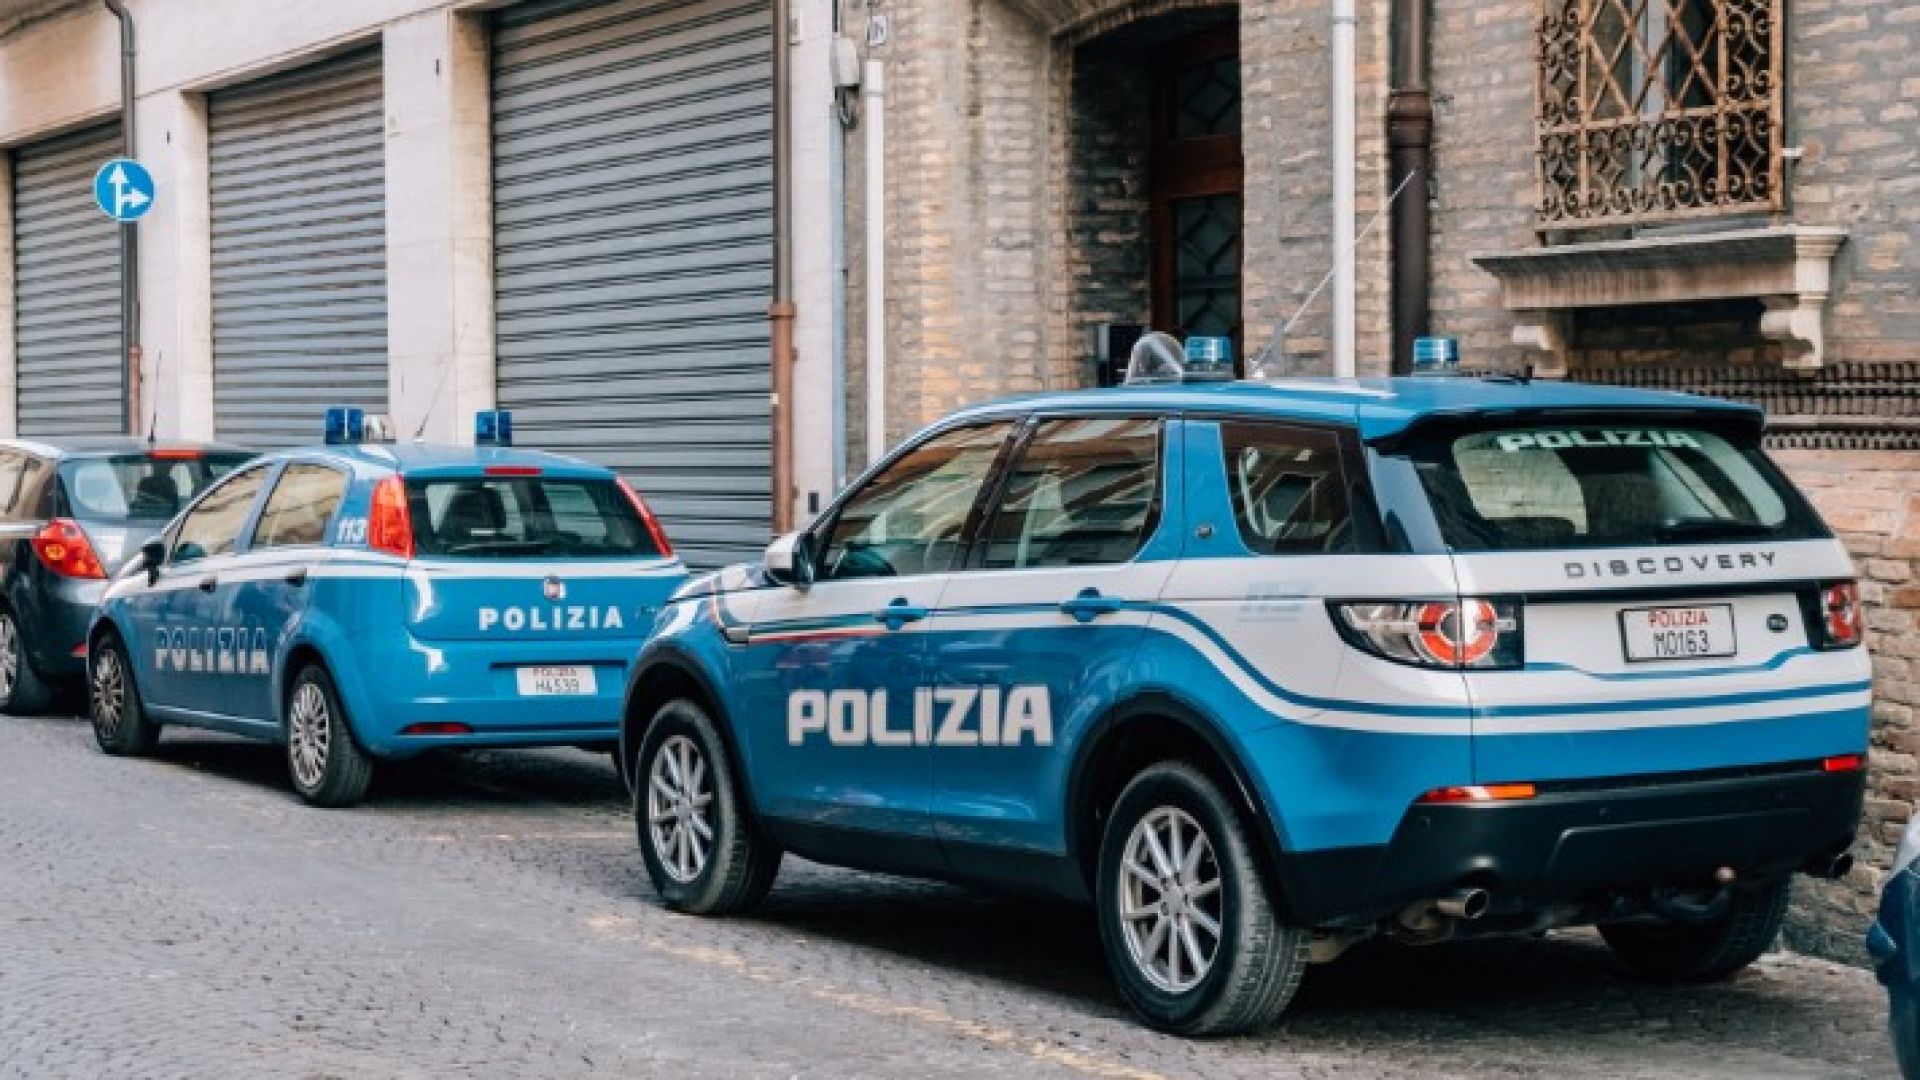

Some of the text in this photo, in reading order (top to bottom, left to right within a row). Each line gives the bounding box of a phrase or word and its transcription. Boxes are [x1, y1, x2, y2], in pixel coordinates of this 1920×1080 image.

[1497, 430, 1702, 452] POLIZIA
[1564, 552, 1776, 578] DISCOVERY
[478, 605, 624, 631] POLIZIA
[1648, 610, 1709, 629] POLIZIA
[155, 626, 270, 674] POLIZIA
[787, 685, 1054, 747] POLIZIA
